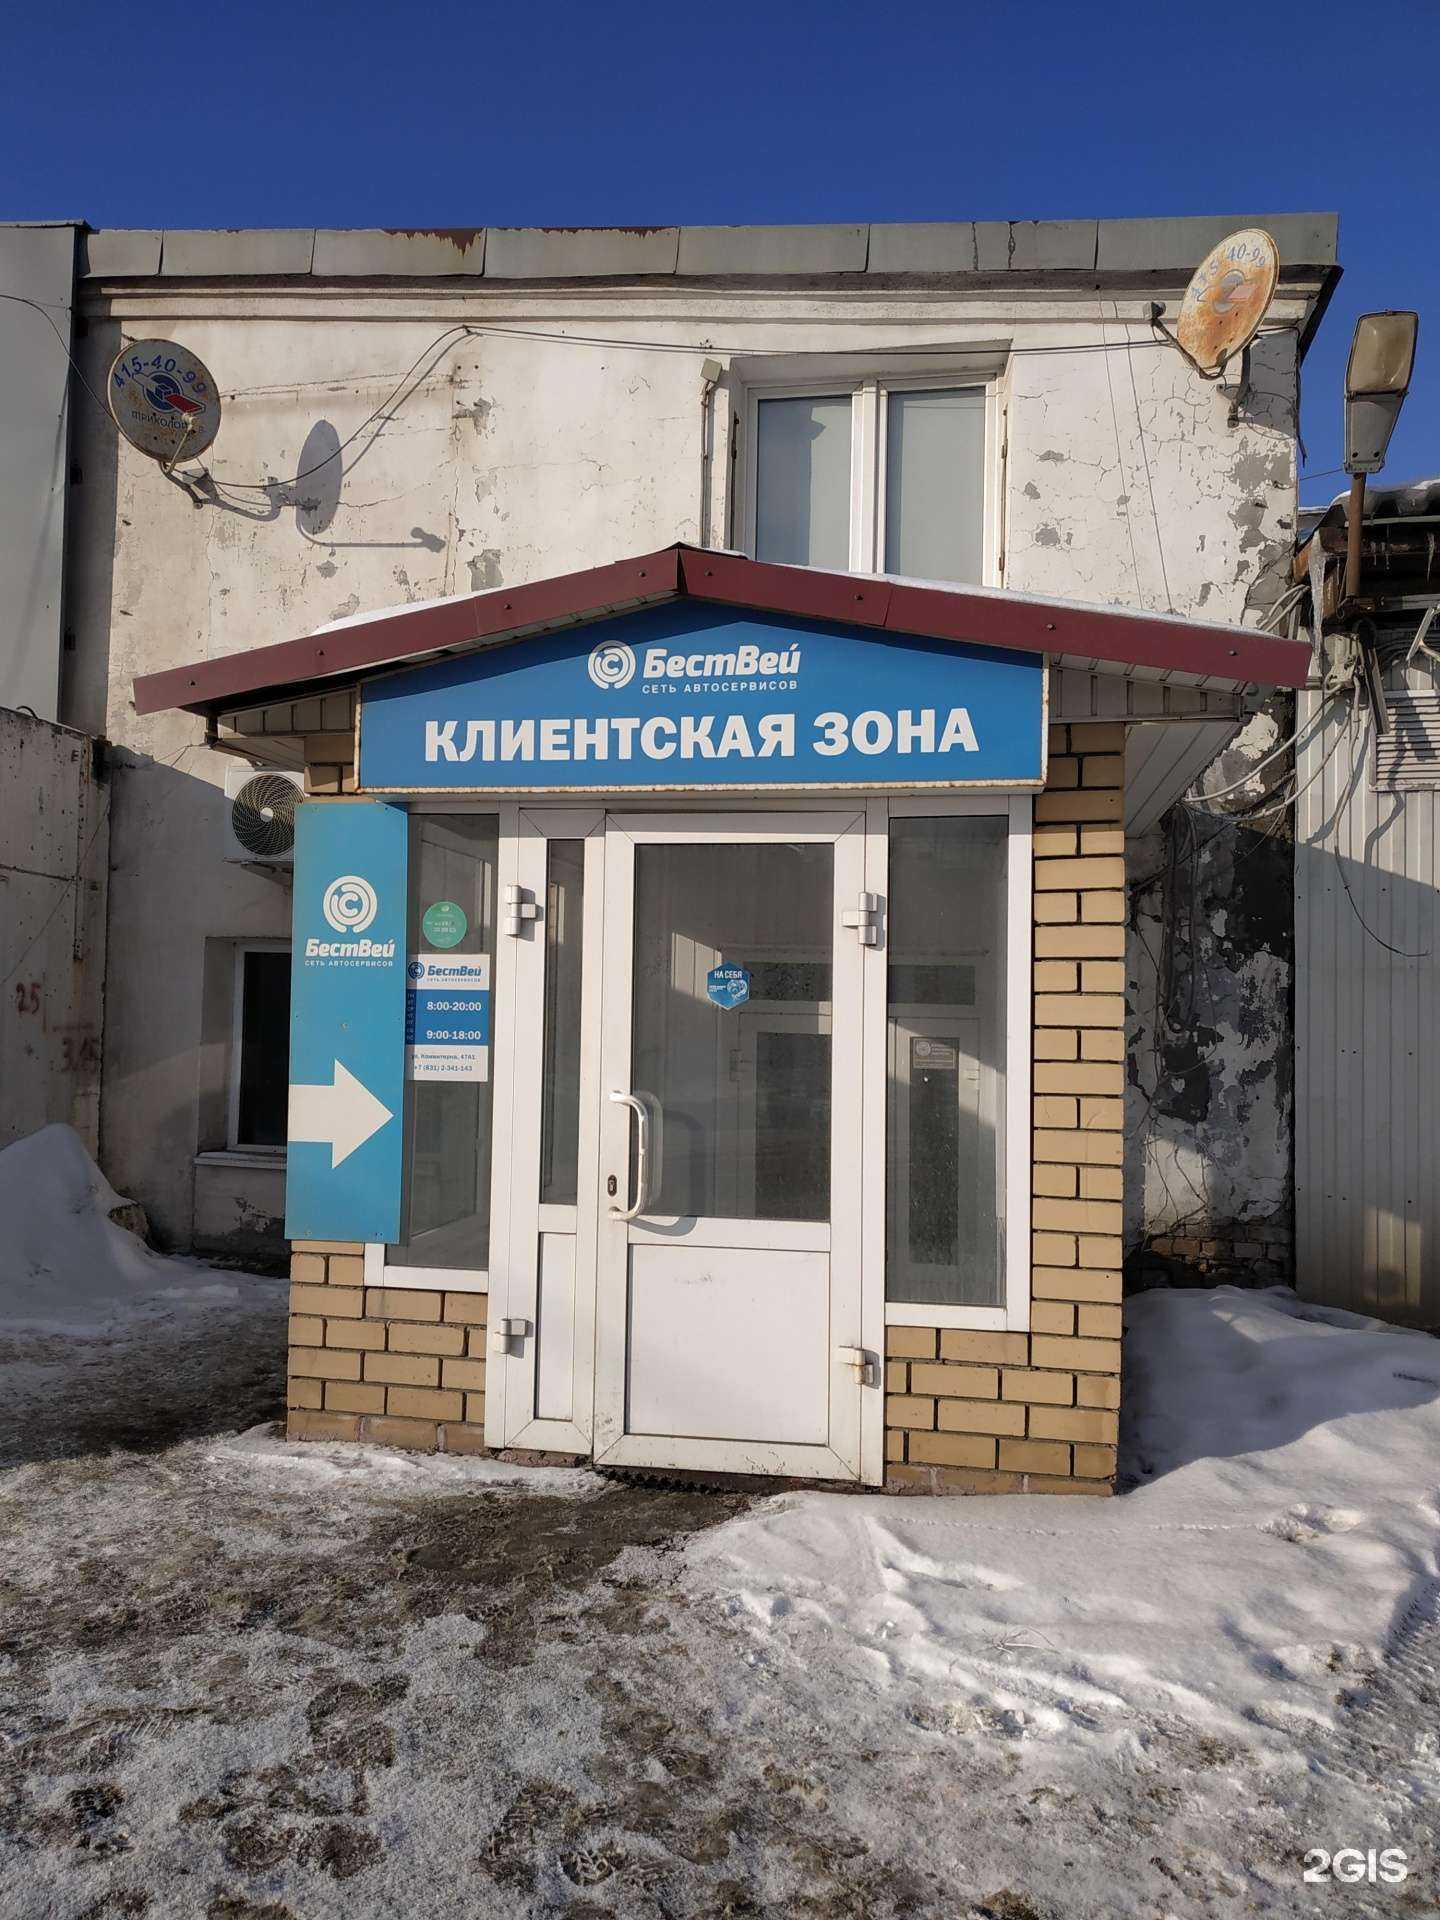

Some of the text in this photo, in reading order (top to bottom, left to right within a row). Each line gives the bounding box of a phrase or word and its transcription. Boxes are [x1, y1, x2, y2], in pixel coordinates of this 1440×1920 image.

[113, 355, 207, 396] 415-40-99
[643, 643, 801, 679] БестВей
[642, 680, 798, 695] СЕТЬ АВТОСЕРВИСОВ
[425, 707, 980, 762] КЛИЕНТСКАЯ ЗОНА
[305, 938, 395, 958] БестВей
[304, 959, 393, 968] СЕТЬ АВТОСЕРВИСОВ
[714, 970, 724, 979] НА
[426, 1001, 482, 1012] 8:00-20:00
[426, 1030, 481, 1040] 9:00-18:00
